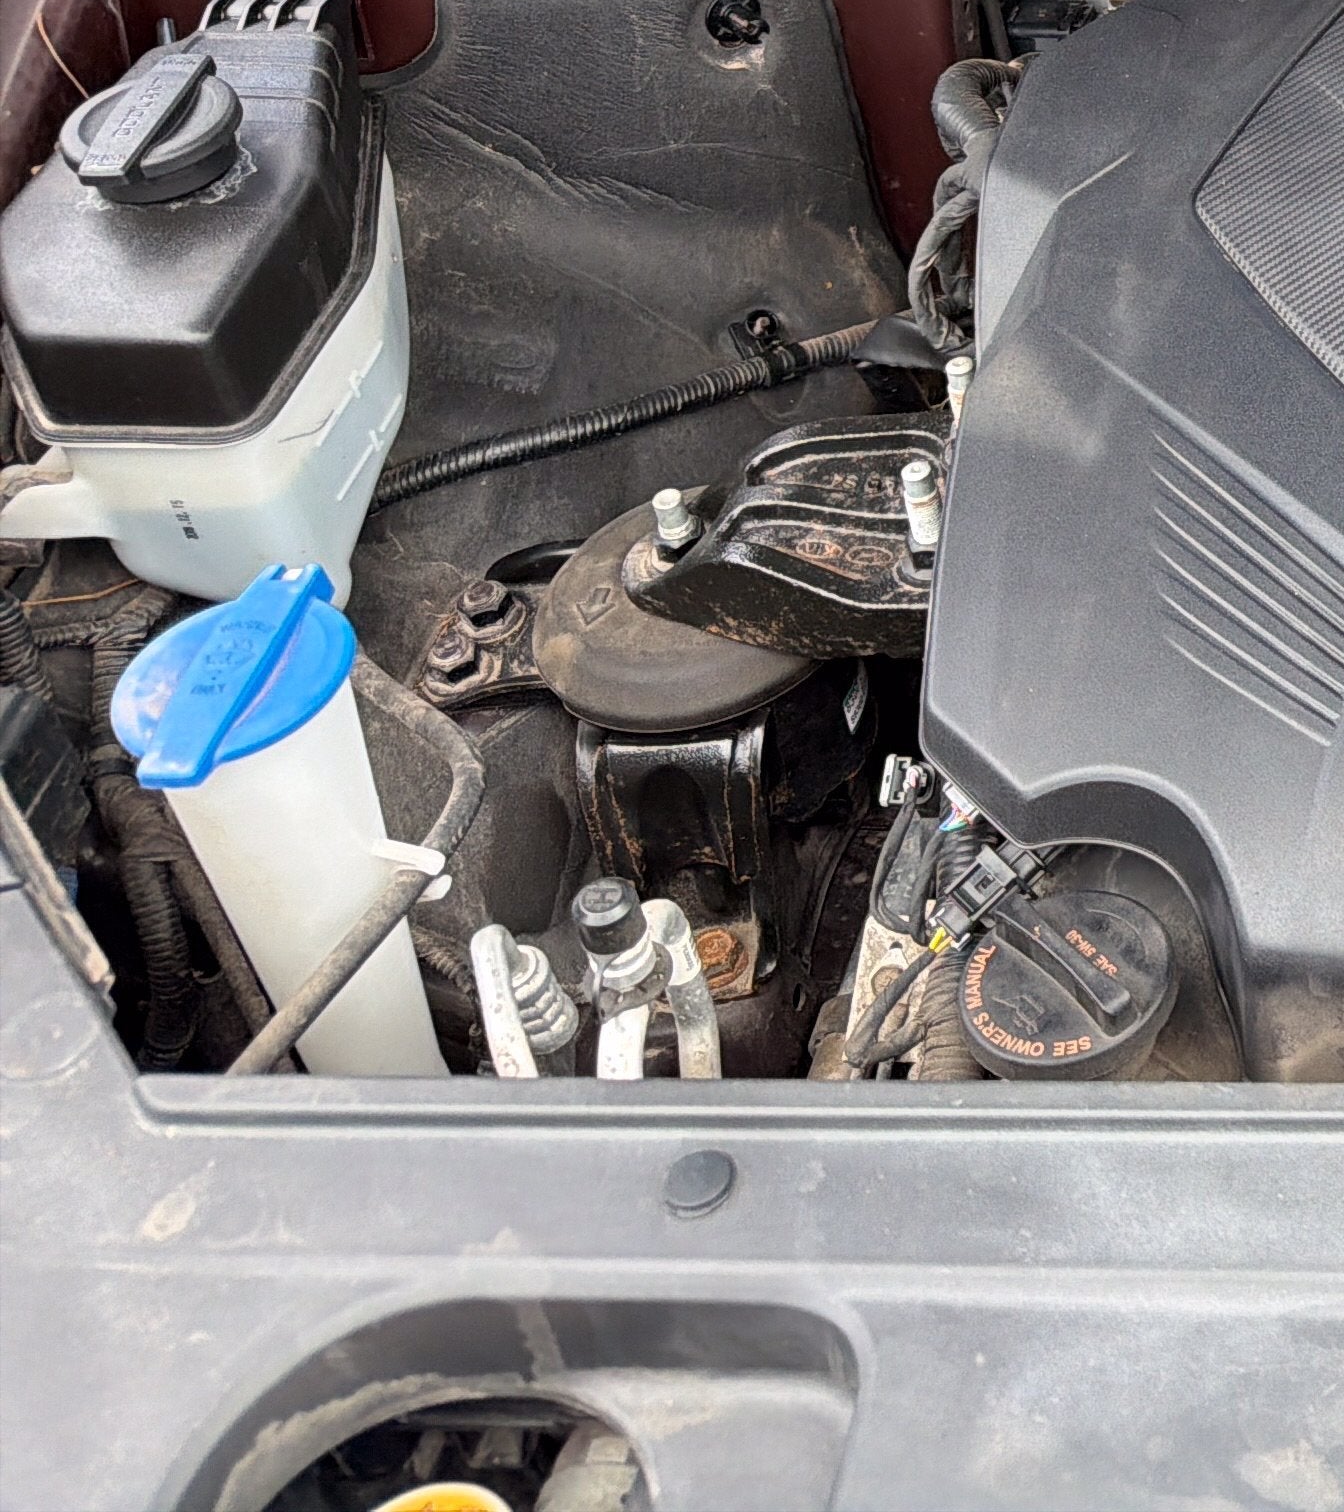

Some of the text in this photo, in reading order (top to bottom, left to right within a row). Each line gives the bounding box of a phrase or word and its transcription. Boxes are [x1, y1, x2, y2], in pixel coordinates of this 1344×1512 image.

[1093, 954, 1119, 977] SAE
[964, 944, 1093, 1057] SEE OWNER'S MANUAL
